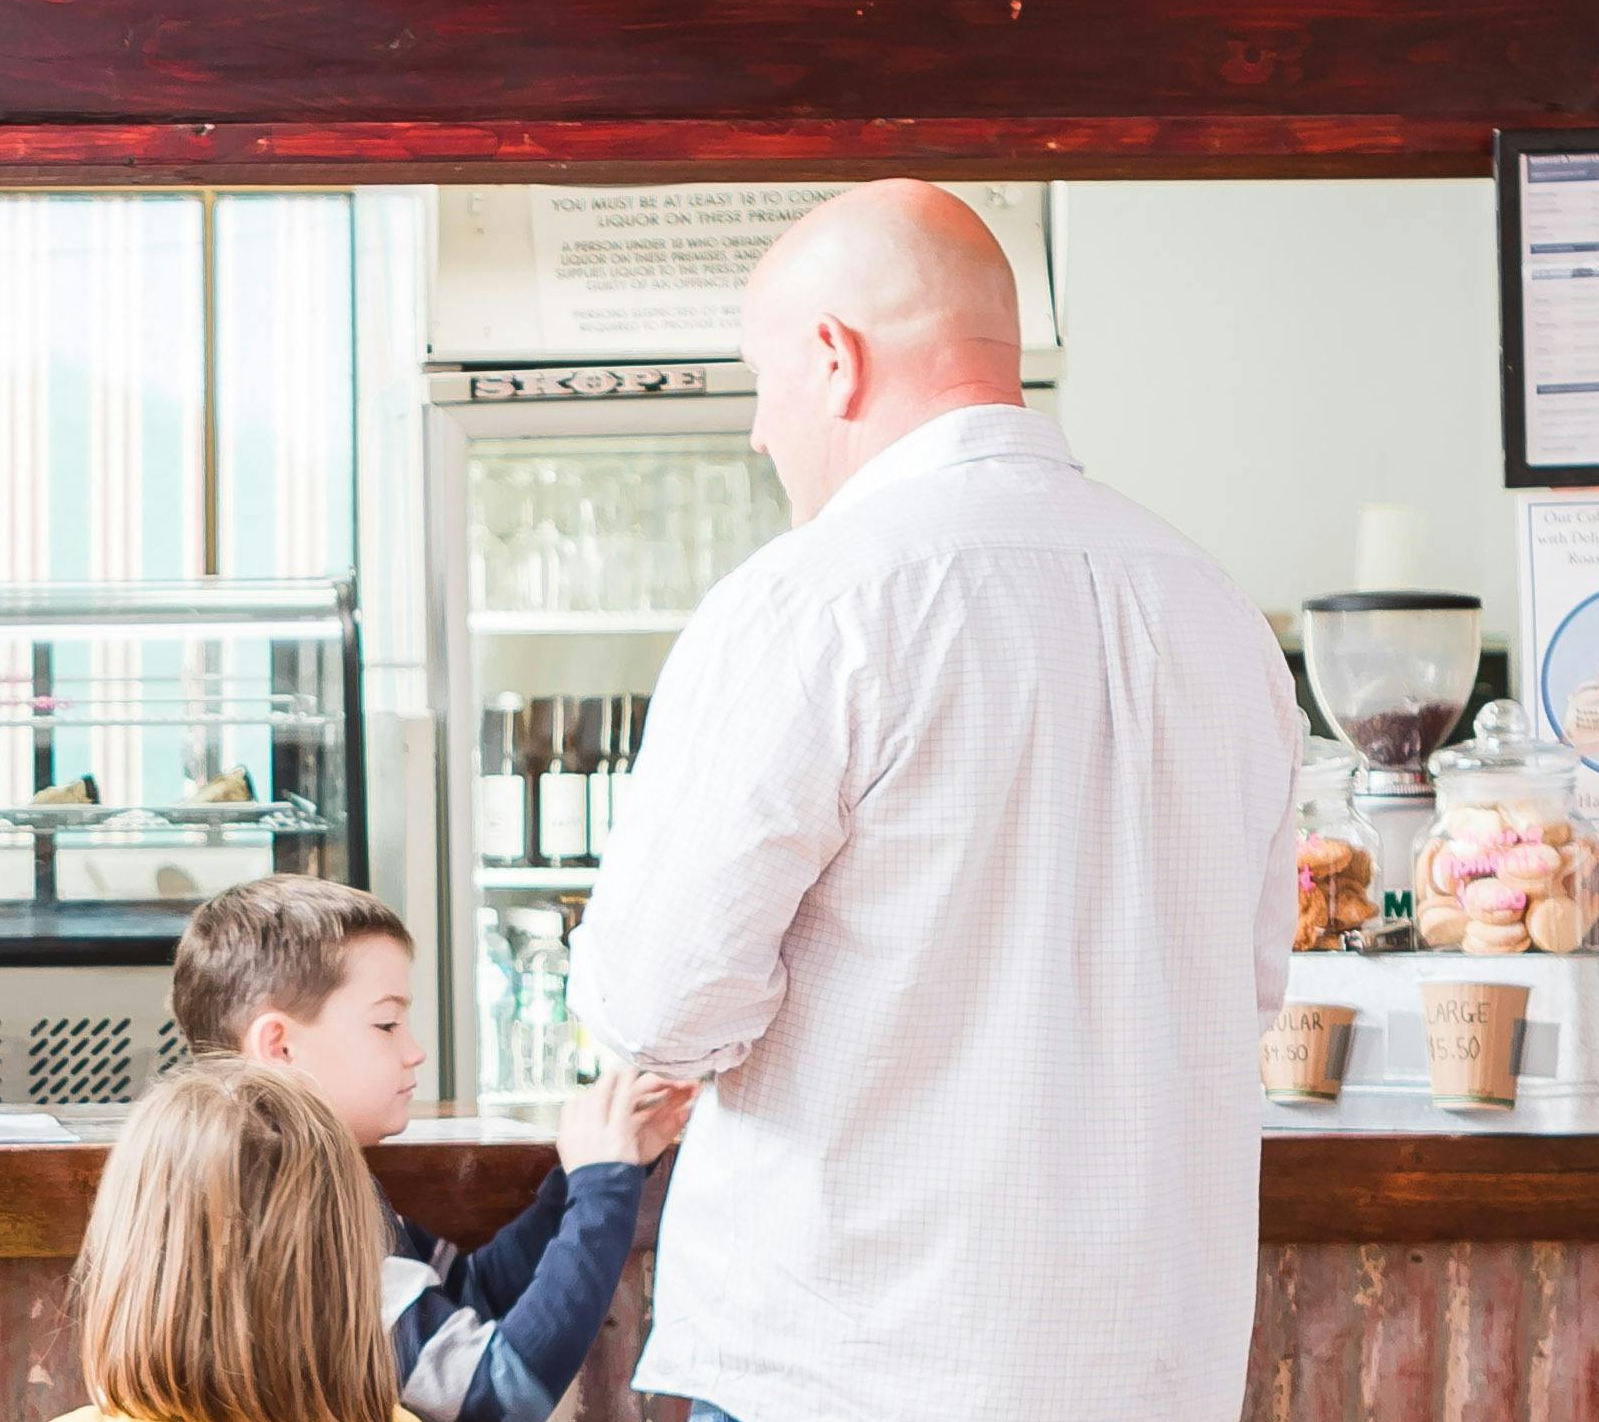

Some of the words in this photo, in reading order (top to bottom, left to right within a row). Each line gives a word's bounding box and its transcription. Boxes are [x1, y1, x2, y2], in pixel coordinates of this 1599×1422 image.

[553, 198, 585, 212] YOU
[592, 195, 634, 210] MUST
[639, 194, 657, 208] BE
[664, 194, 683, 209] AT
[687, 193, 734, 207] LEAST
[741, 192, 756, 205] 18
[761, 191, 782, 204] TO
[598, 213, 659, 228] LIQUOR
[665, 212, 691, 225] ON
[697, 210, 741, 224] THESE
[1544, 511, 1571, 525] Our
[1537, 532, 1567, 545] with
[1267, 1012, 1323, 1031] ULAR
[1426, 1000, 1491, 1025] LARGE
[1428, 1035, 1481, 1062] $5.50
